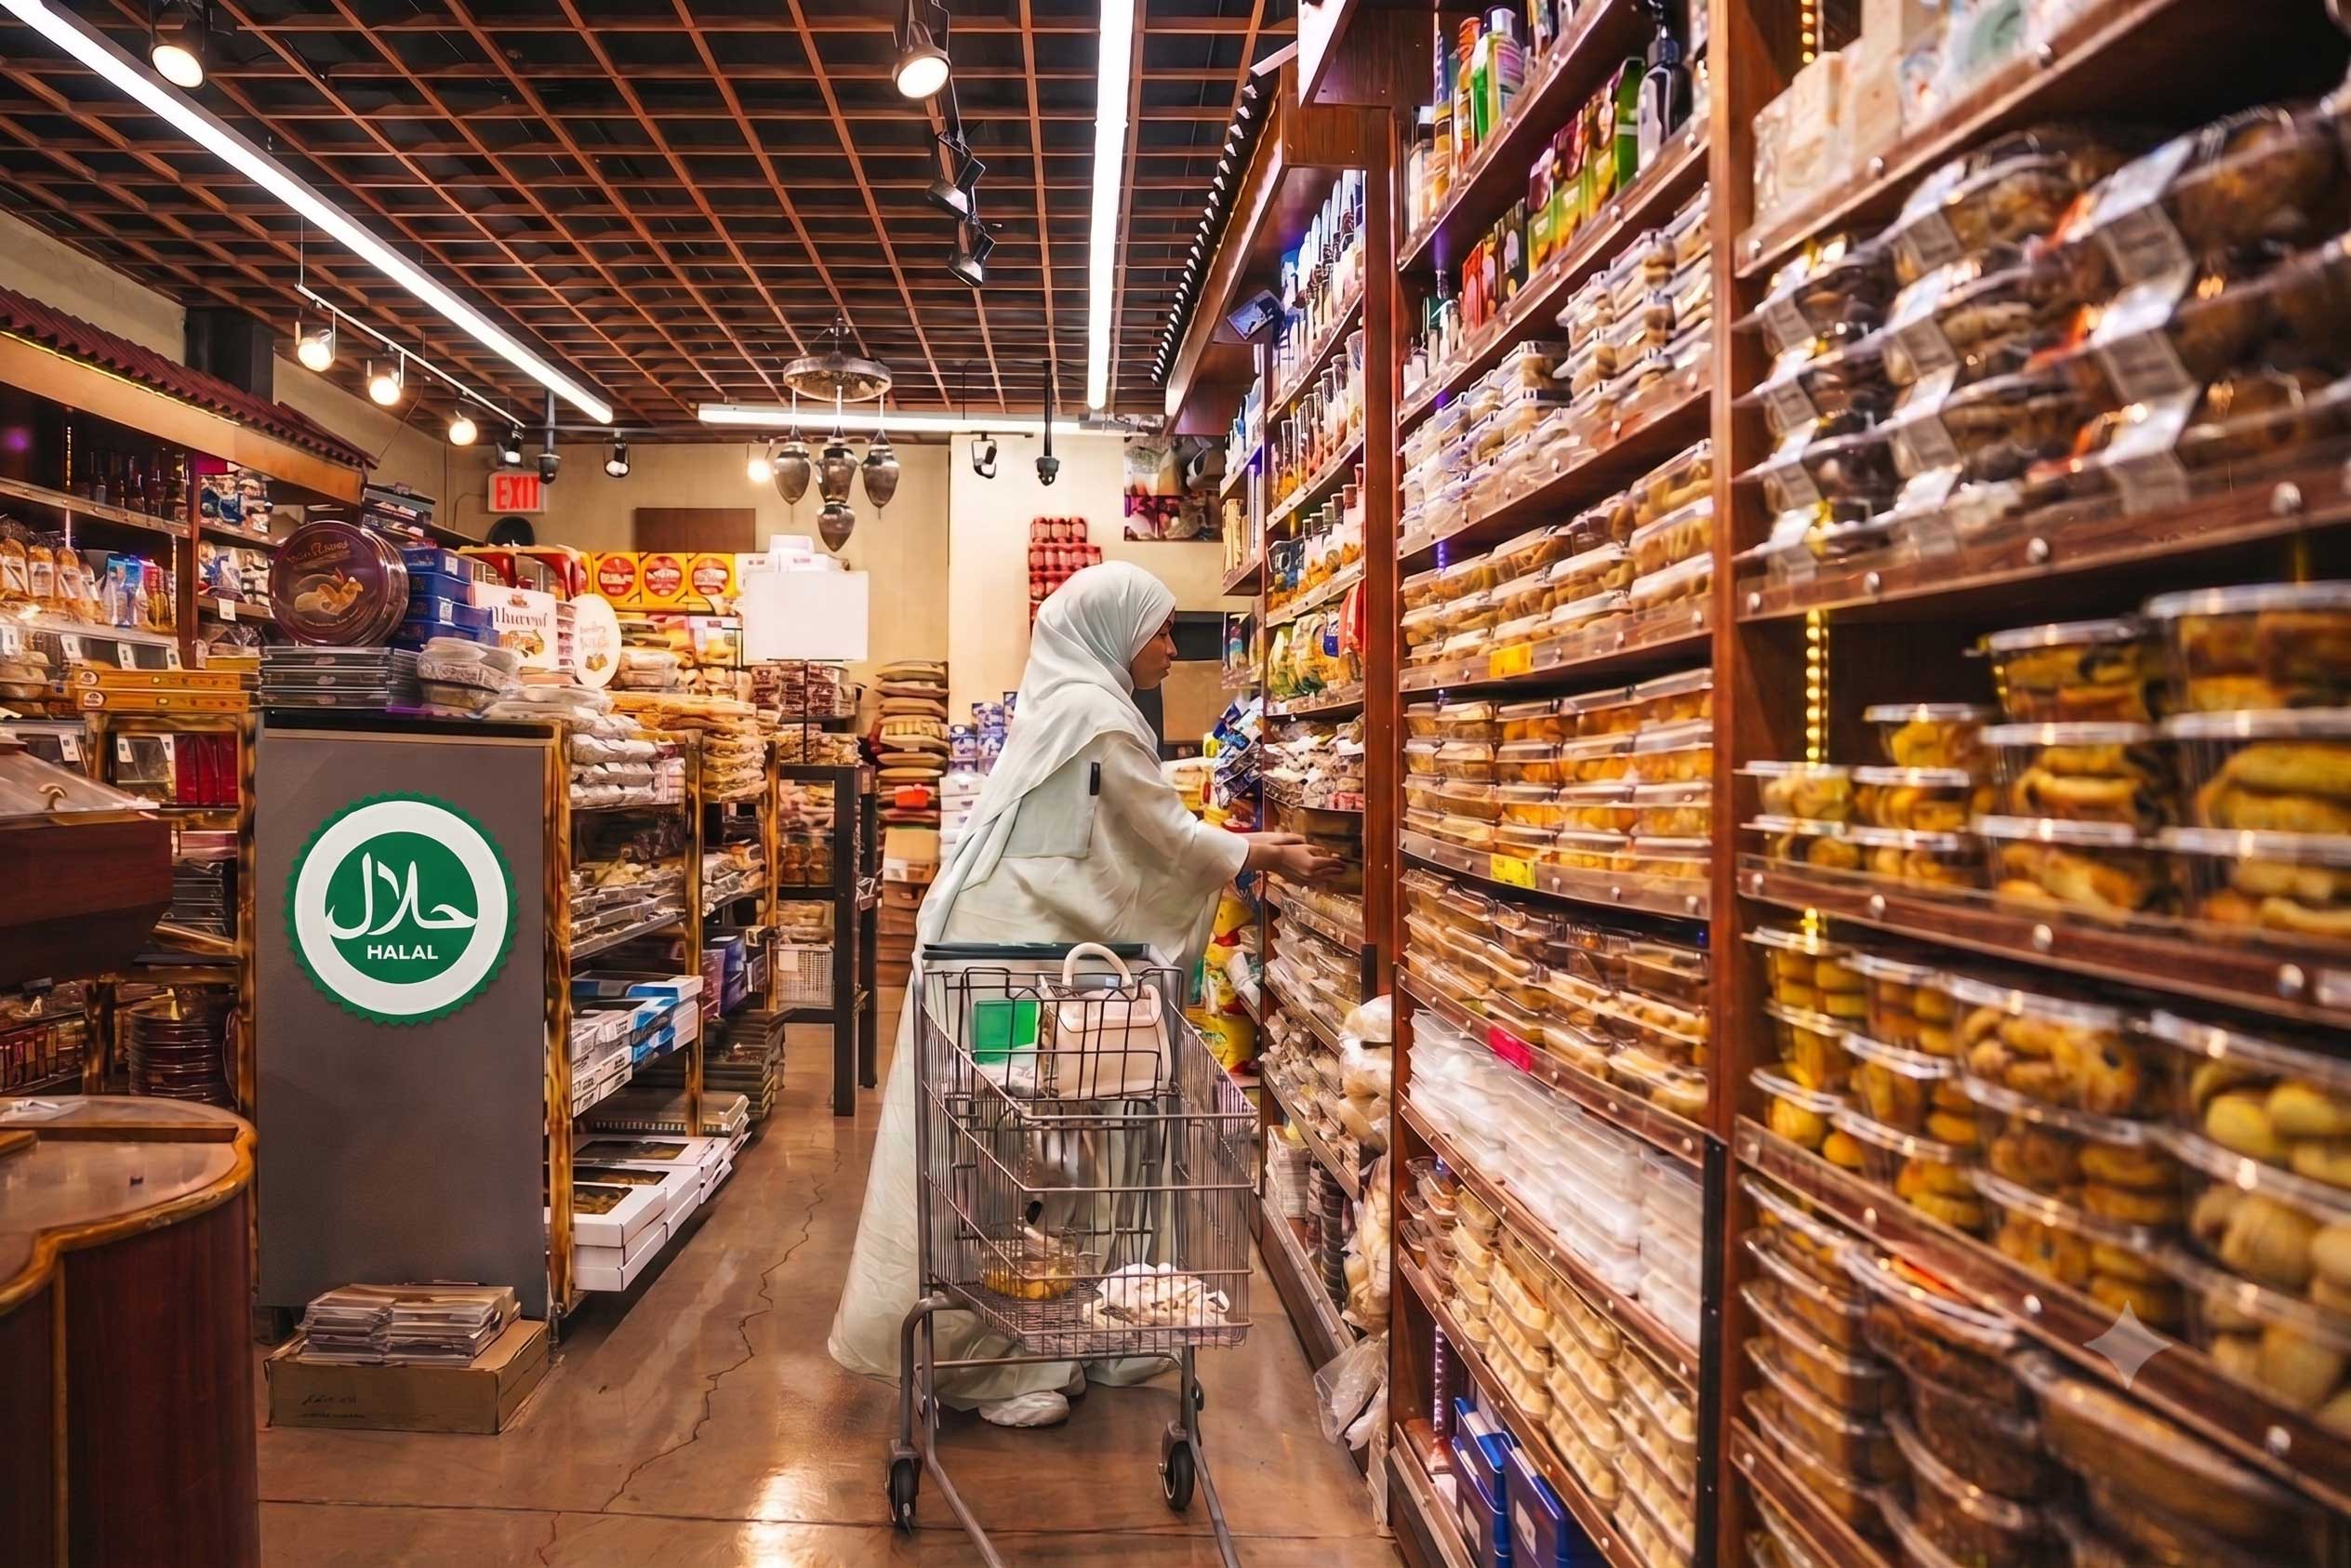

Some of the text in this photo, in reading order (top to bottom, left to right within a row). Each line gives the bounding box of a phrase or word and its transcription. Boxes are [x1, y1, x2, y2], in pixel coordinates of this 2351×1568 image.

[496, 475, 539, 510] EXIT
[325, 852, 477, 939] حلال
[366, 945, 439, 960] HALAL
